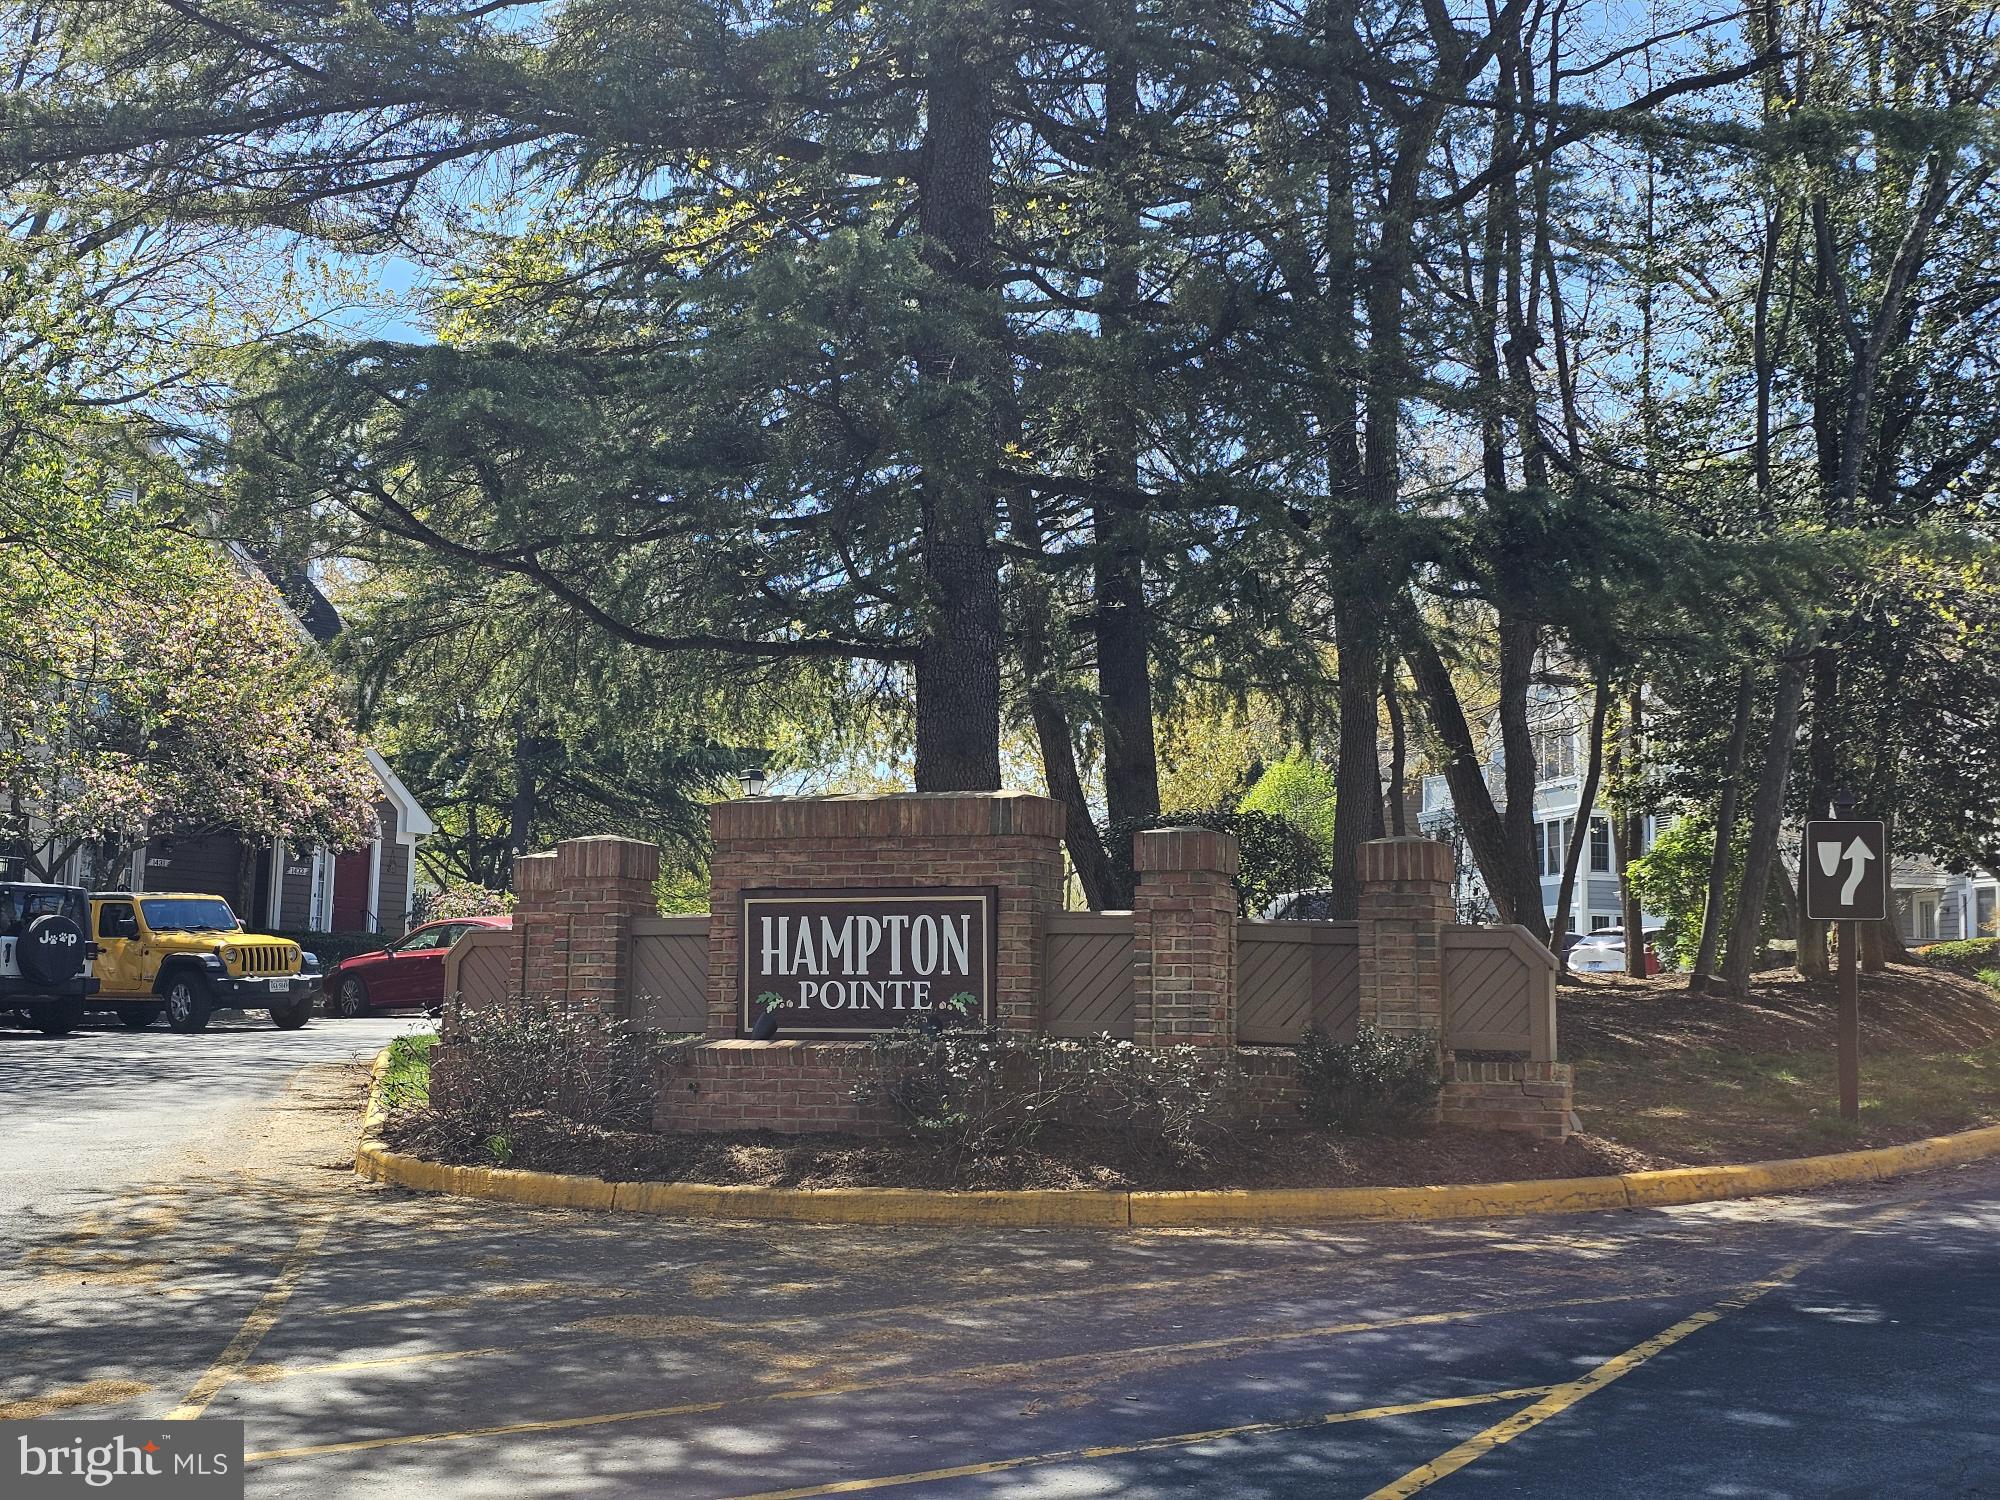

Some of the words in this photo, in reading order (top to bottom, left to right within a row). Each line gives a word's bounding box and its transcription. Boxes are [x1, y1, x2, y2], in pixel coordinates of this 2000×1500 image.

[39, 930, 77, 946] Jp
[760, 914, 971, 976] HAMPTON
[798, 980, 933, 1010] POINTE
